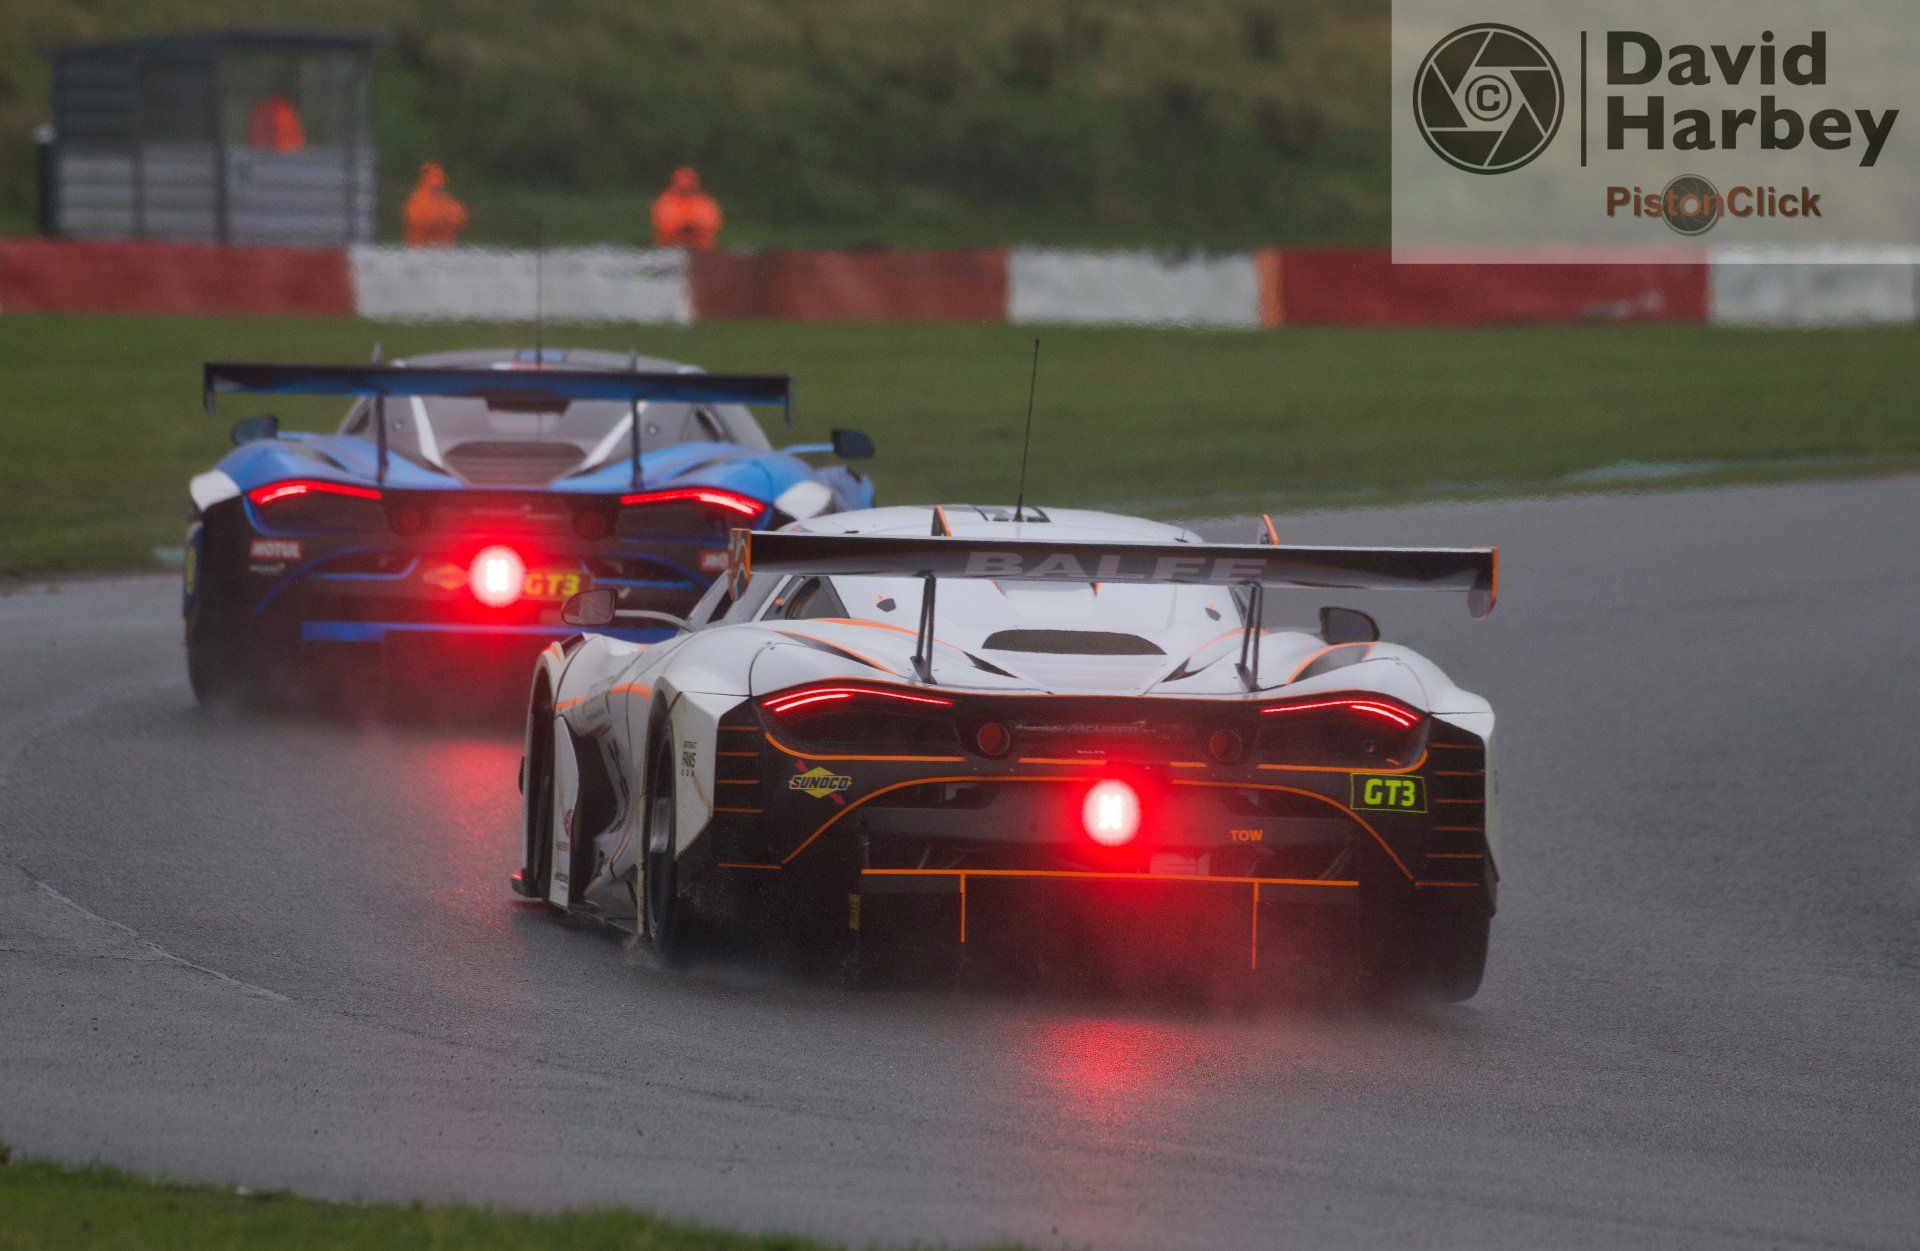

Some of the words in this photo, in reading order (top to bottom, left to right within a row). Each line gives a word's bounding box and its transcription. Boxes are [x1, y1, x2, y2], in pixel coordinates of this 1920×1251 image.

[963, 551, 1268, 583] BALFE
[524, 572, 581, 597] GT3
[790, 775, 850, 790] SUNOCO
[1363, 778, 1416, 807] GT3
[1230, 829, 1264, 842] TOW
